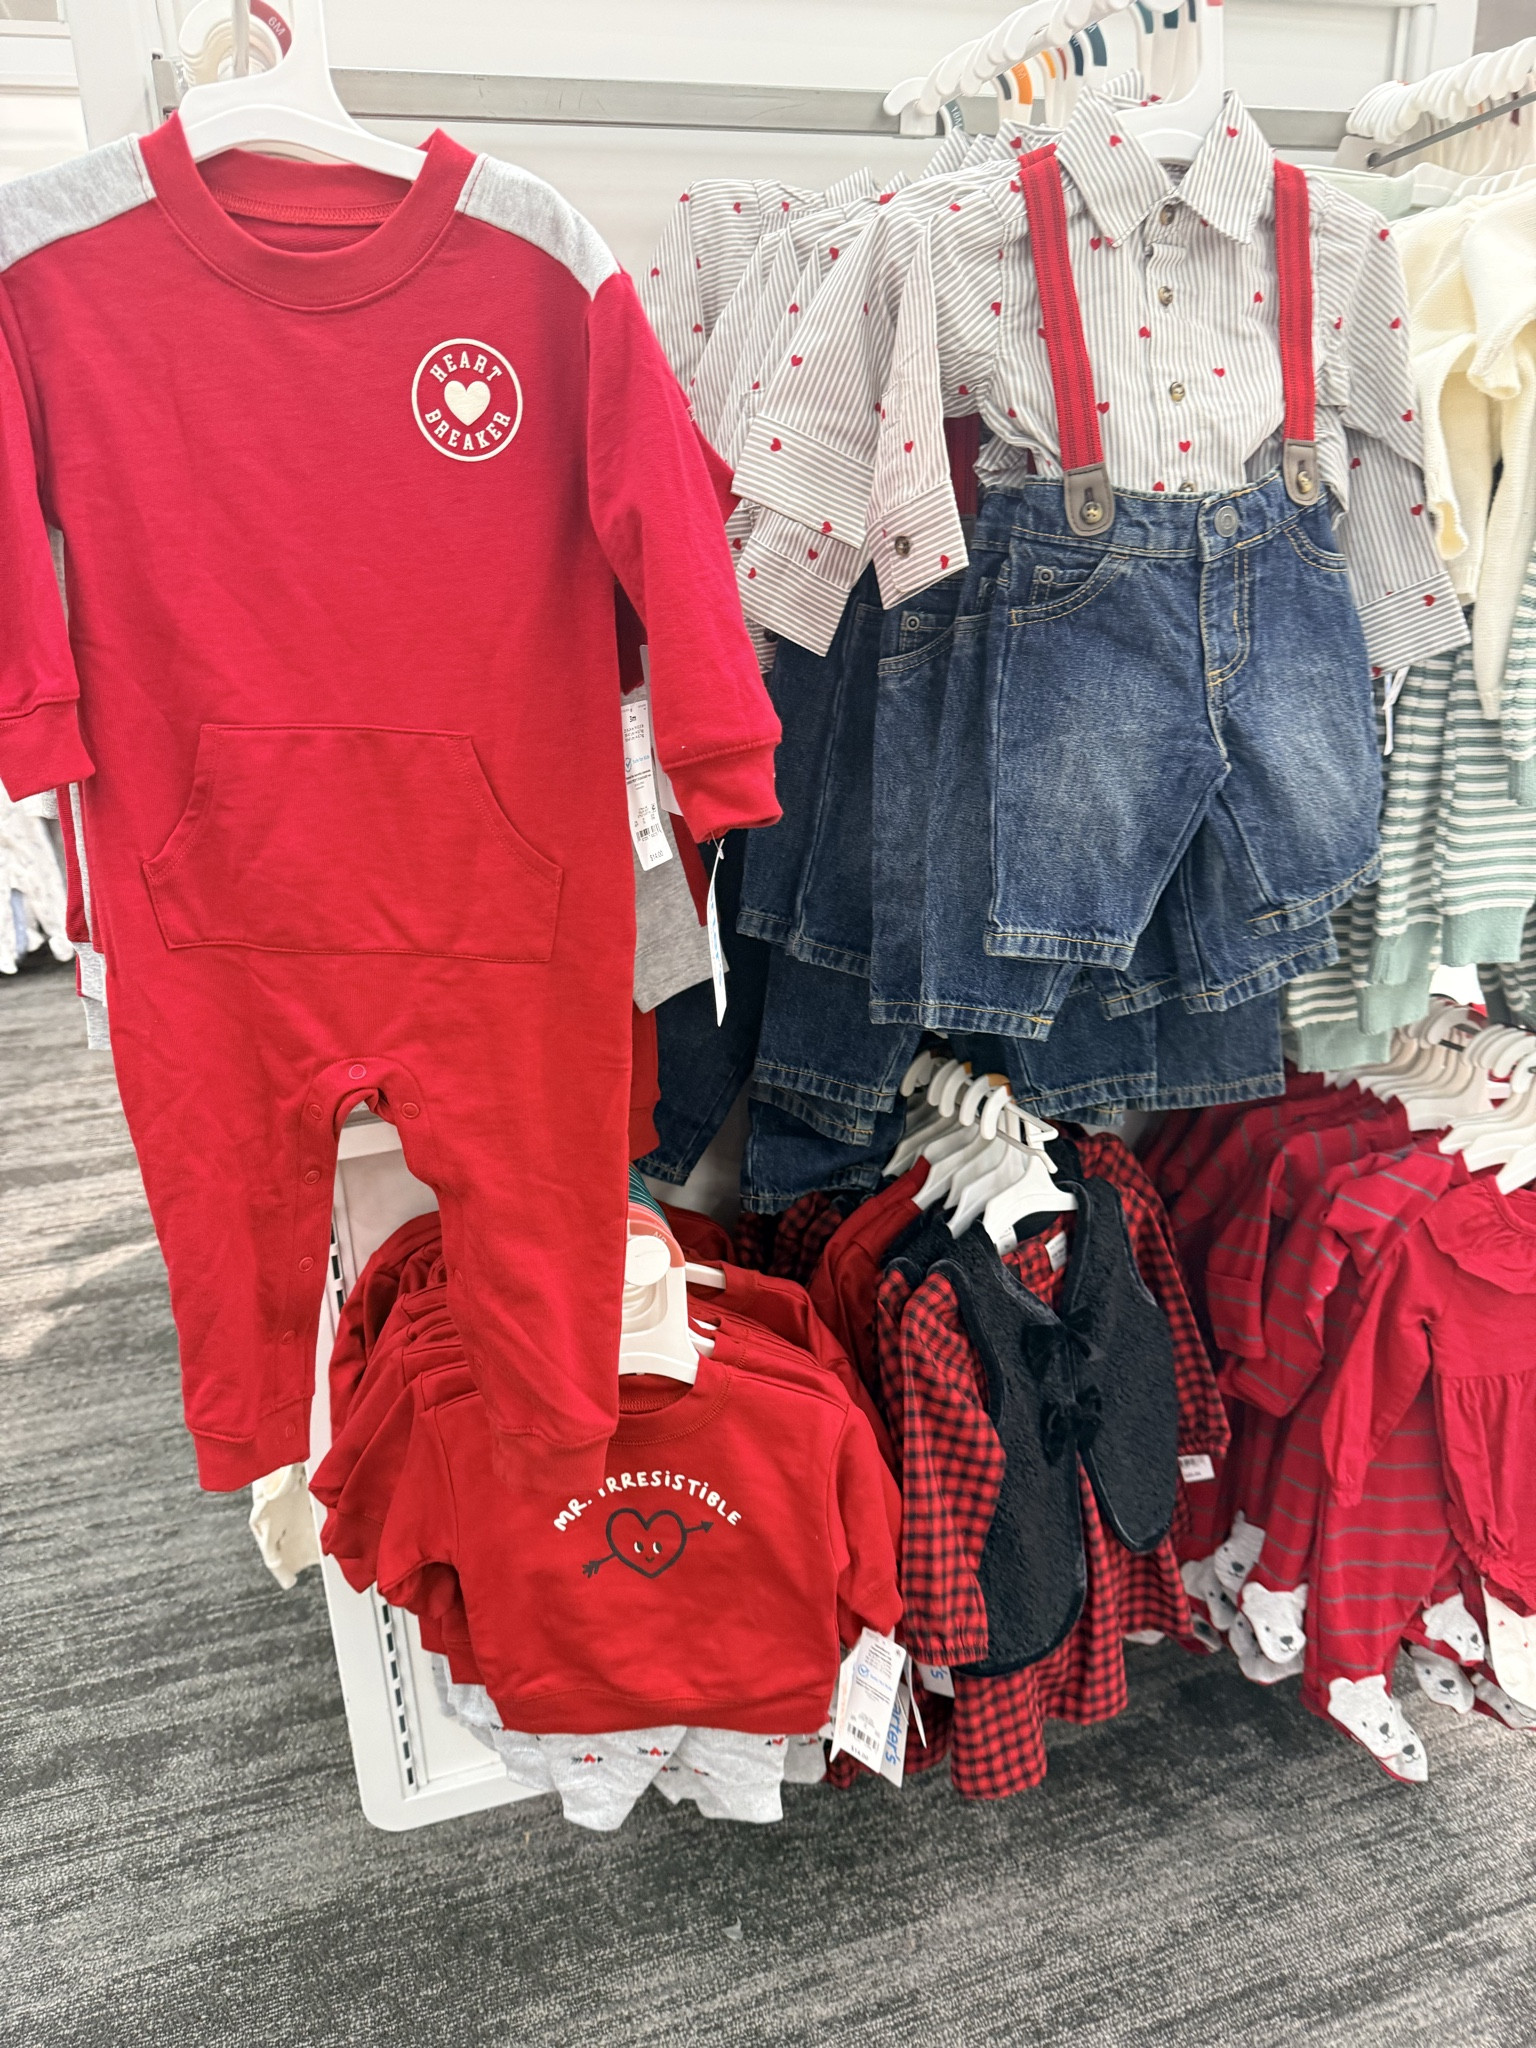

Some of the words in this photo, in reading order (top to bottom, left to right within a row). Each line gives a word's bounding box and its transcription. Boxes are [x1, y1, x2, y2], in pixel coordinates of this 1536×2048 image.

[268, 15, 286, 36] 6M
[429, 350, 503, 383] HEART
[424, 408, 511, 451] BREAKER
[553, 1498, 592, 1532] MR.
[884, 1702, 903, 1766] arter's
